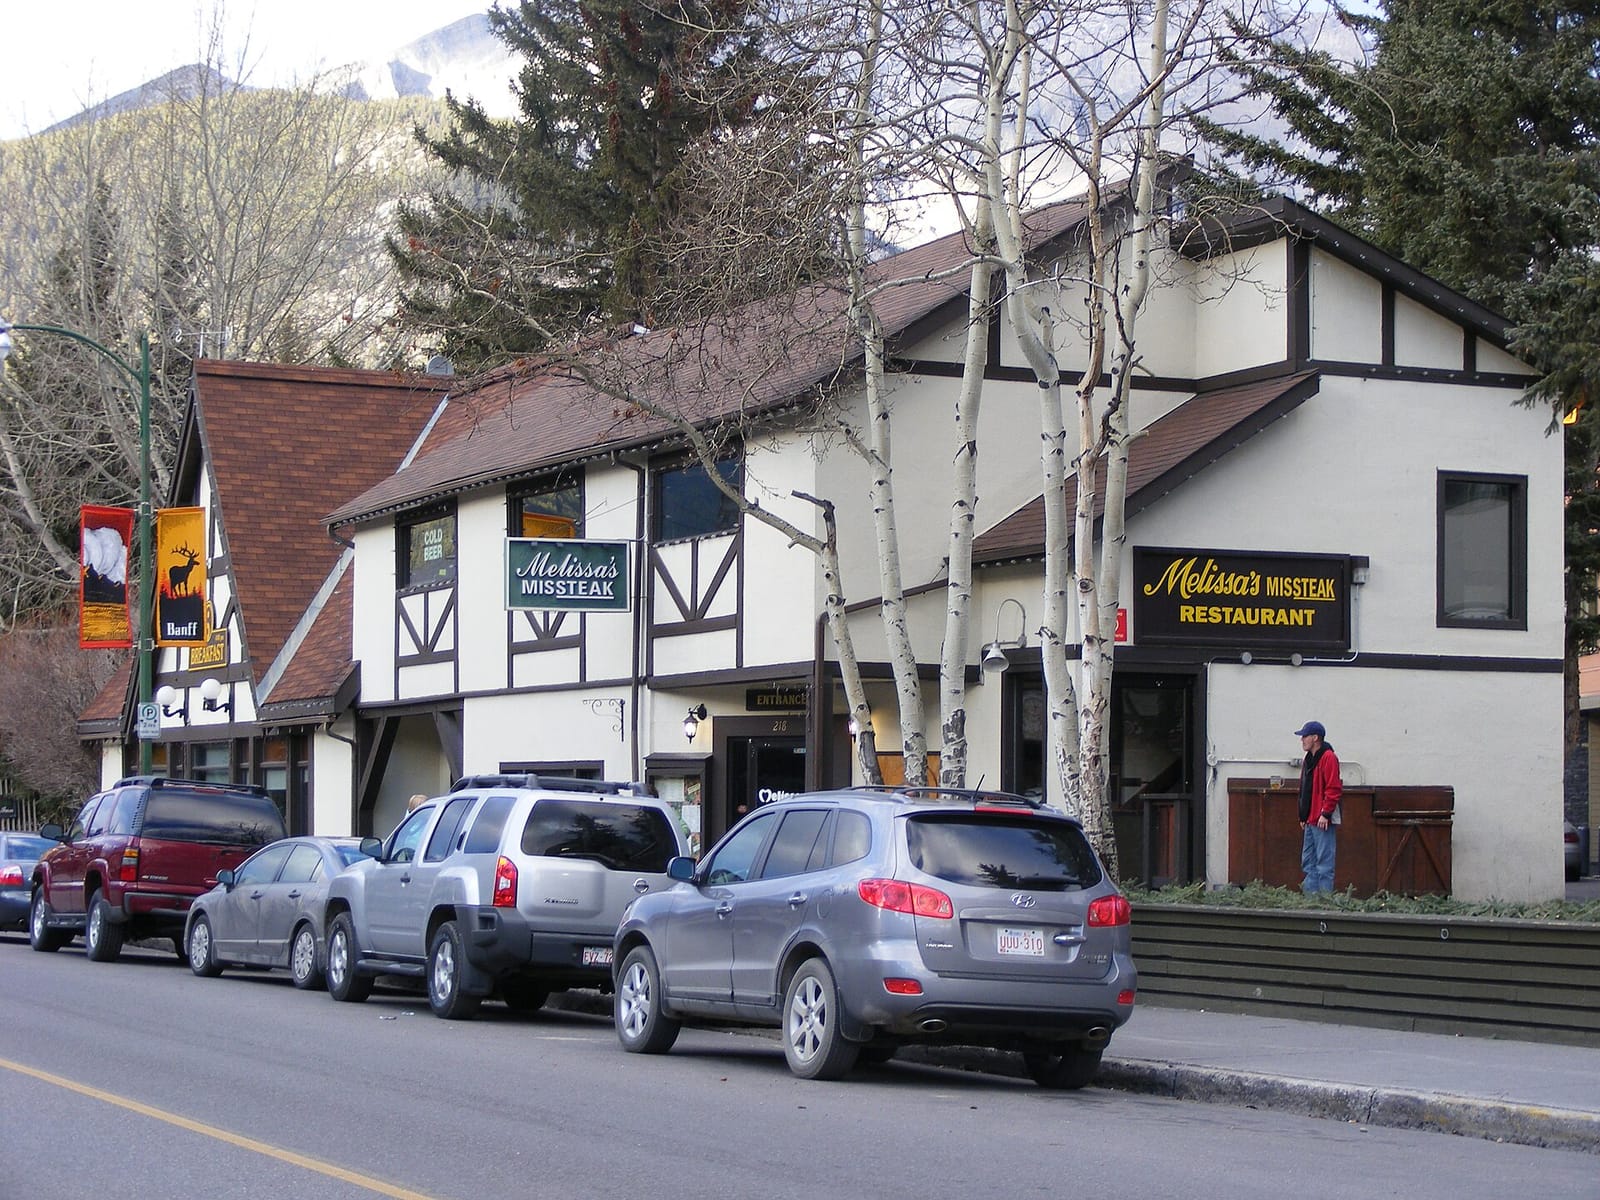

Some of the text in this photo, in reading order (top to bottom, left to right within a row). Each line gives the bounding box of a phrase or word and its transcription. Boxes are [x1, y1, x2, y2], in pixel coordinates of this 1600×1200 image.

[424, 528, 443, 545] COLD
[424, 544, 443, 562] BEER
[516, 552, 619, 579] Melissa's
[1143, 556, 1336, 600] Melissa's MISSTEAK
[521, 579, 615, 599] MISSTEAK
[1179, 605, 1316, 626] RESTAURANT
[167, 622, 198, 636] Banff
[190, 643, 225, 665] BREAKFAST
[757, 694, 807, 705] ENTRANCE
